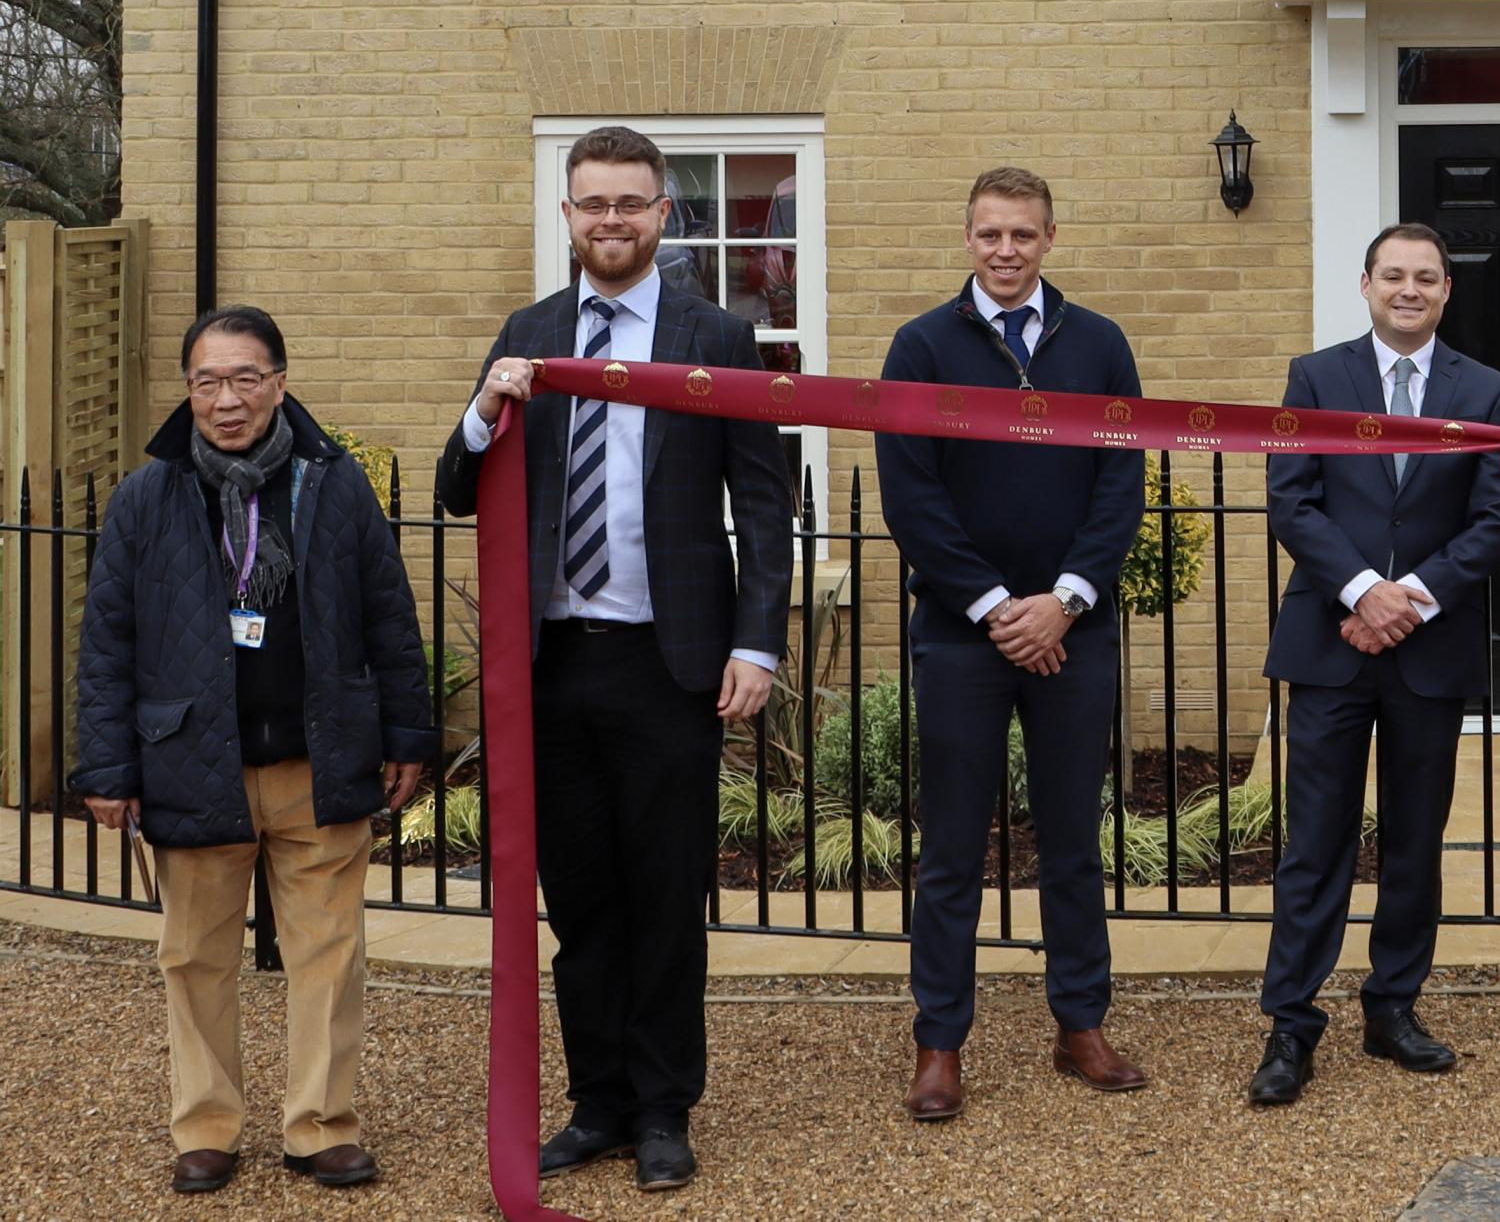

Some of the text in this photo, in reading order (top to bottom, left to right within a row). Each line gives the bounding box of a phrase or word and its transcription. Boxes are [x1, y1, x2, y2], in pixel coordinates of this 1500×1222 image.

[1009, 426, 1055, 435] DENBURY
[1093, 431, 1138, 440] DENBURY
[1176, 436, 1222, 445] DENBURY
